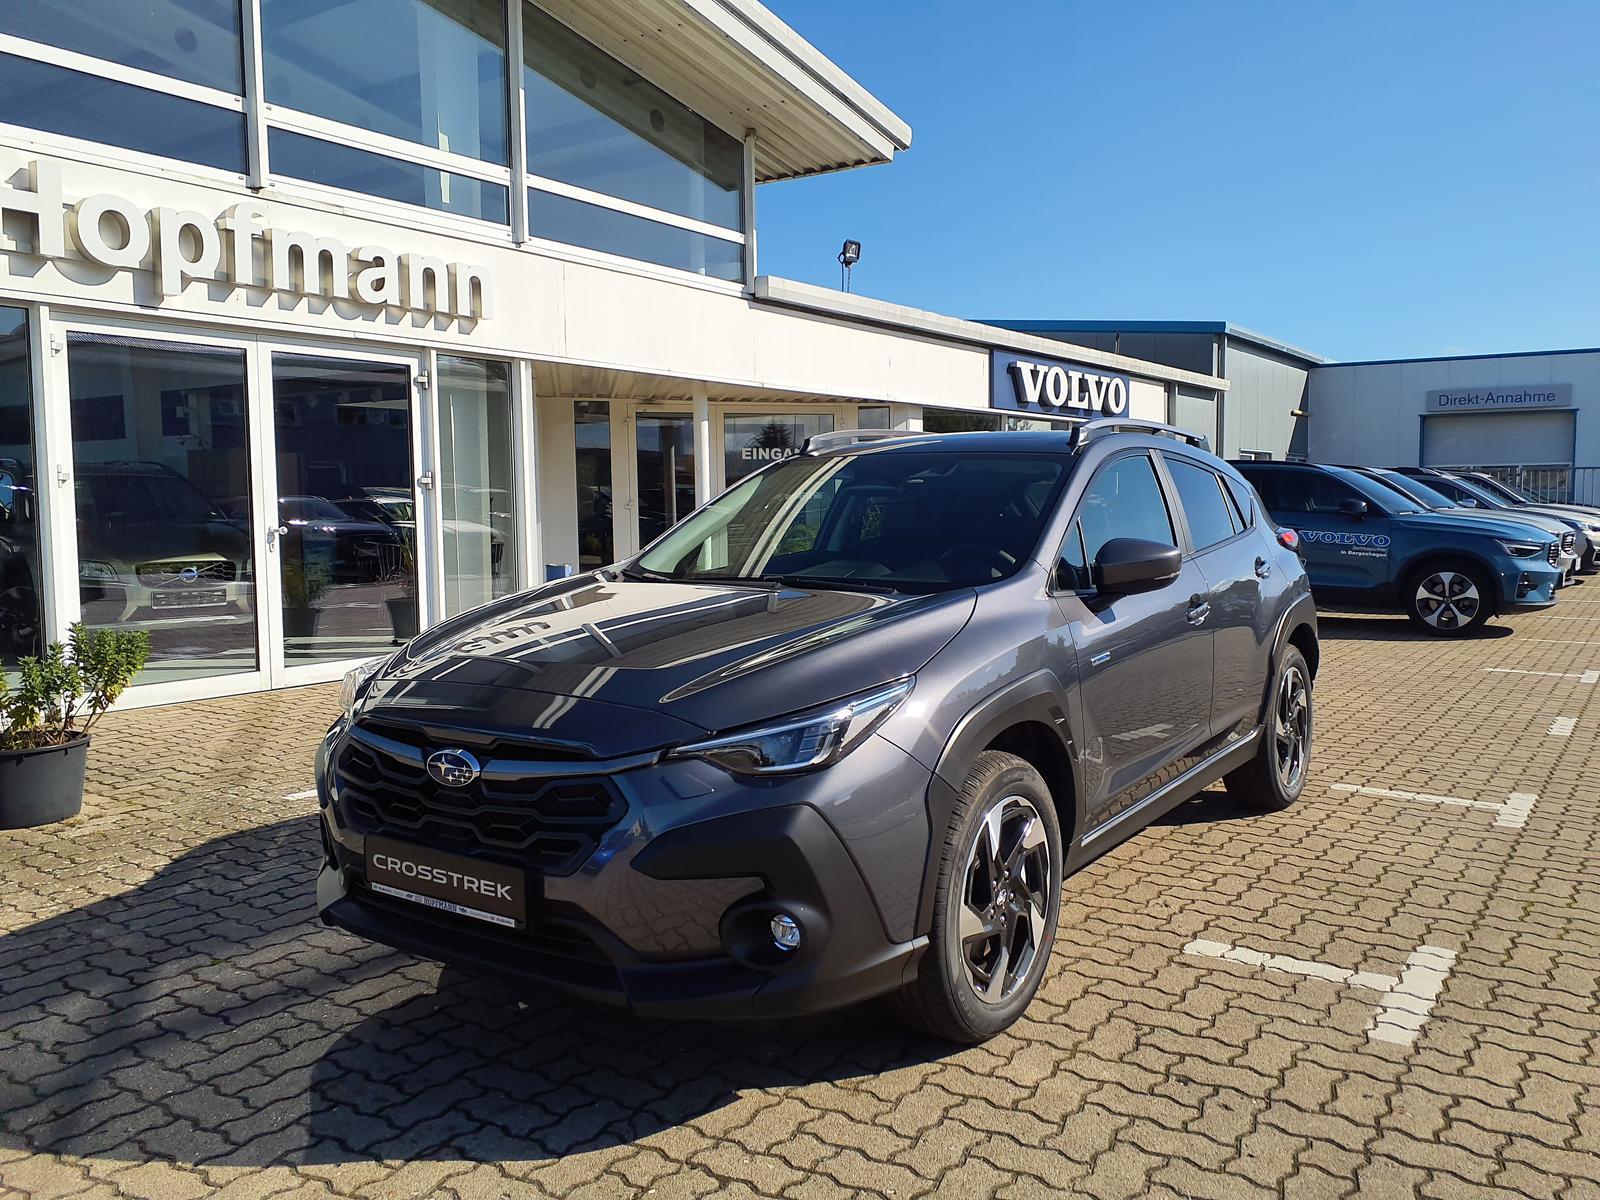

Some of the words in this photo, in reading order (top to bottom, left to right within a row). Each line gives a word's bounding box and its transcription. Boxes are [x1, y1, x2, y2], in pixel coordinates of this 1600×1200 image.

[1011, 360, 1127, 415] VOLVO
[1438, 390, 1556, 407] Direkt-Annahme
[1299, 530, 1391, 547] VOLVO
[372, 853, 513, 901] CROSSTREK
